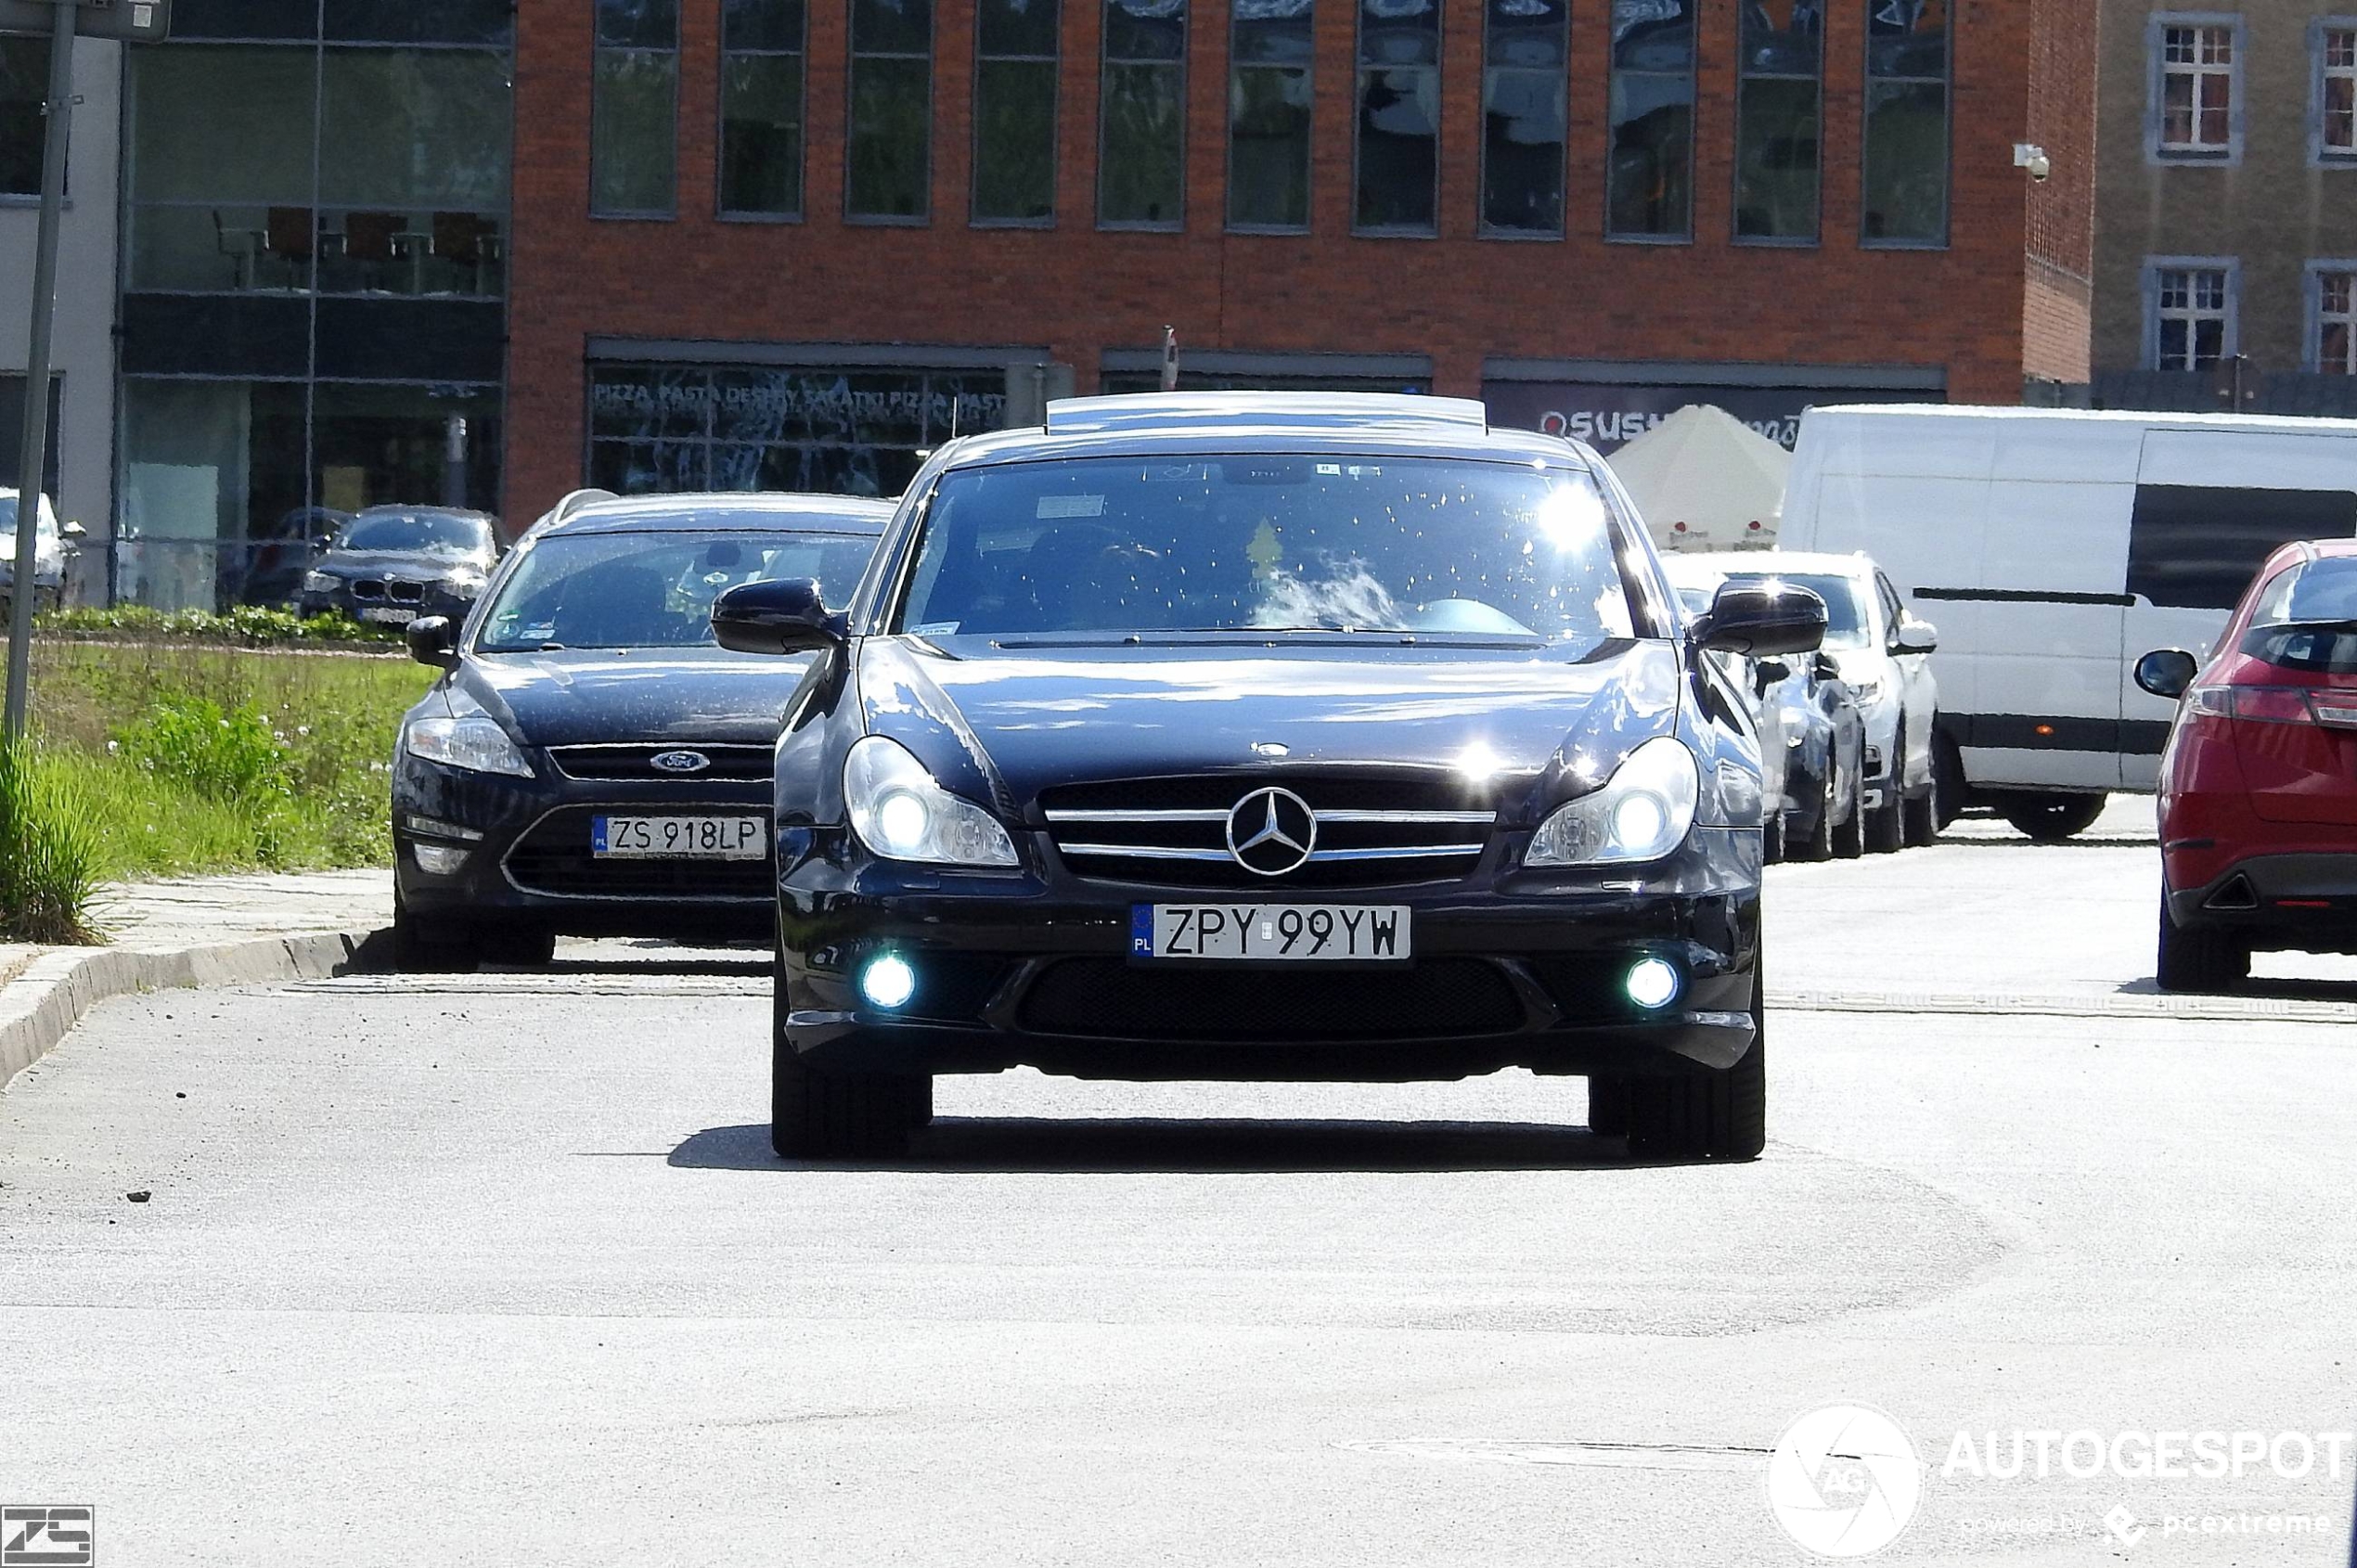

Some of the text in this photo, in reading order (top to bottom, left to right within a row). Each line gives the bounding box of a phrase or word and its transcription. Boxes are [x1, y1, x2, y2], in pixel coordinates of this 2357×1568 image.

[594, 383, 649, 401] PIZZA
[665, 754, 692, 767] Ford
[613, 820, 756, 849] ZS 918LP
[1166, 908, 1397, 956] ZPY 99YW
[1134, 938, 1152, 951] PL
